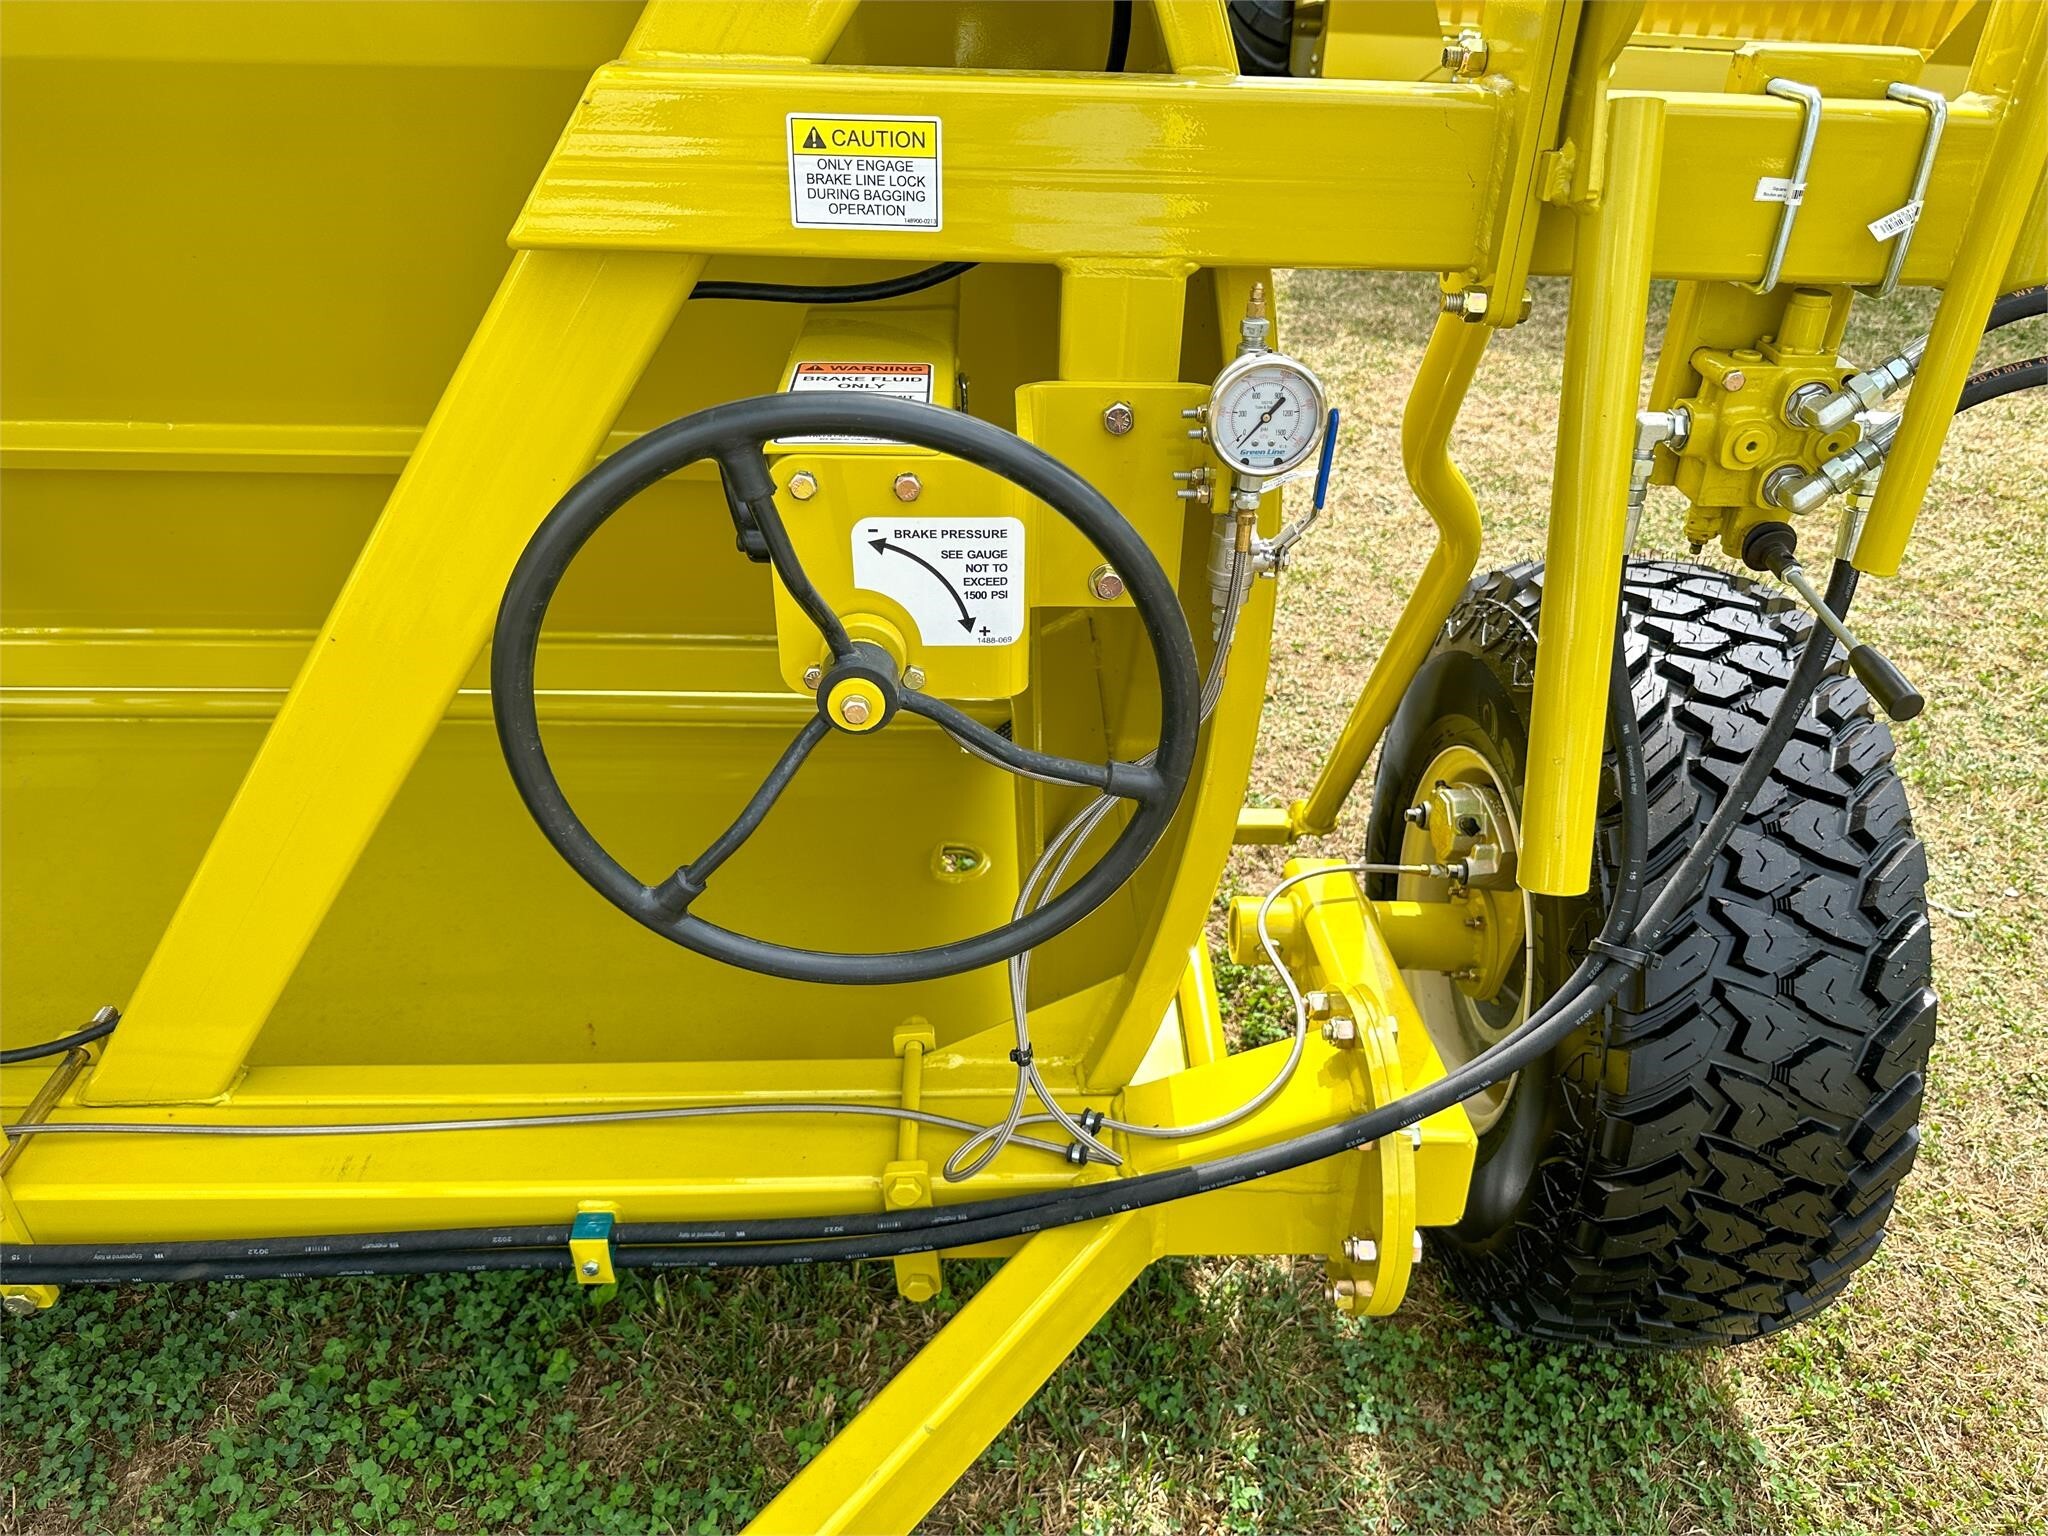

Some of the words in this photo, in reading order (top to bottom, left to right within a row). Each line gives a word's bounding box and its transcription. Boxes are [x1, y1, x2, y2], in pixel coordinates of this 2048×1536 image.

[831, 129, 926, 149] CAUTION
[817, 158, 853, 171] ONLY
[856, 160, 914, 173] ENGAGE
[806, 173, 852, 186] BRAKE
[856, 174, 886, 187] LINE
[889, 175, 926, 188] LOCK
[807, 188, 860, 201] DURING
[864, 190, 926, 202] BAGGING
[828, 203, 906, 217] OPERATION
[894, 529, 937, 539] BRAKE
[941, 529, 1008, 539] PRESSURE
[940, 550, 964, 559] SEE
[967, 550, 1008, 559] GAUGE
[965, 563, 989, 573] NOT
[992, 563, 1008, 573] TO
[963, 577, 1008, 587] EXCEED
[963, 590, 988, 600] 1500
[990, 590, 1008, 600] PSI
[977, 636, 1013, 644] 1488-069
[1629, 870, 1637, 881] 15
[1574, 1008, 1595, 1026] 2022
